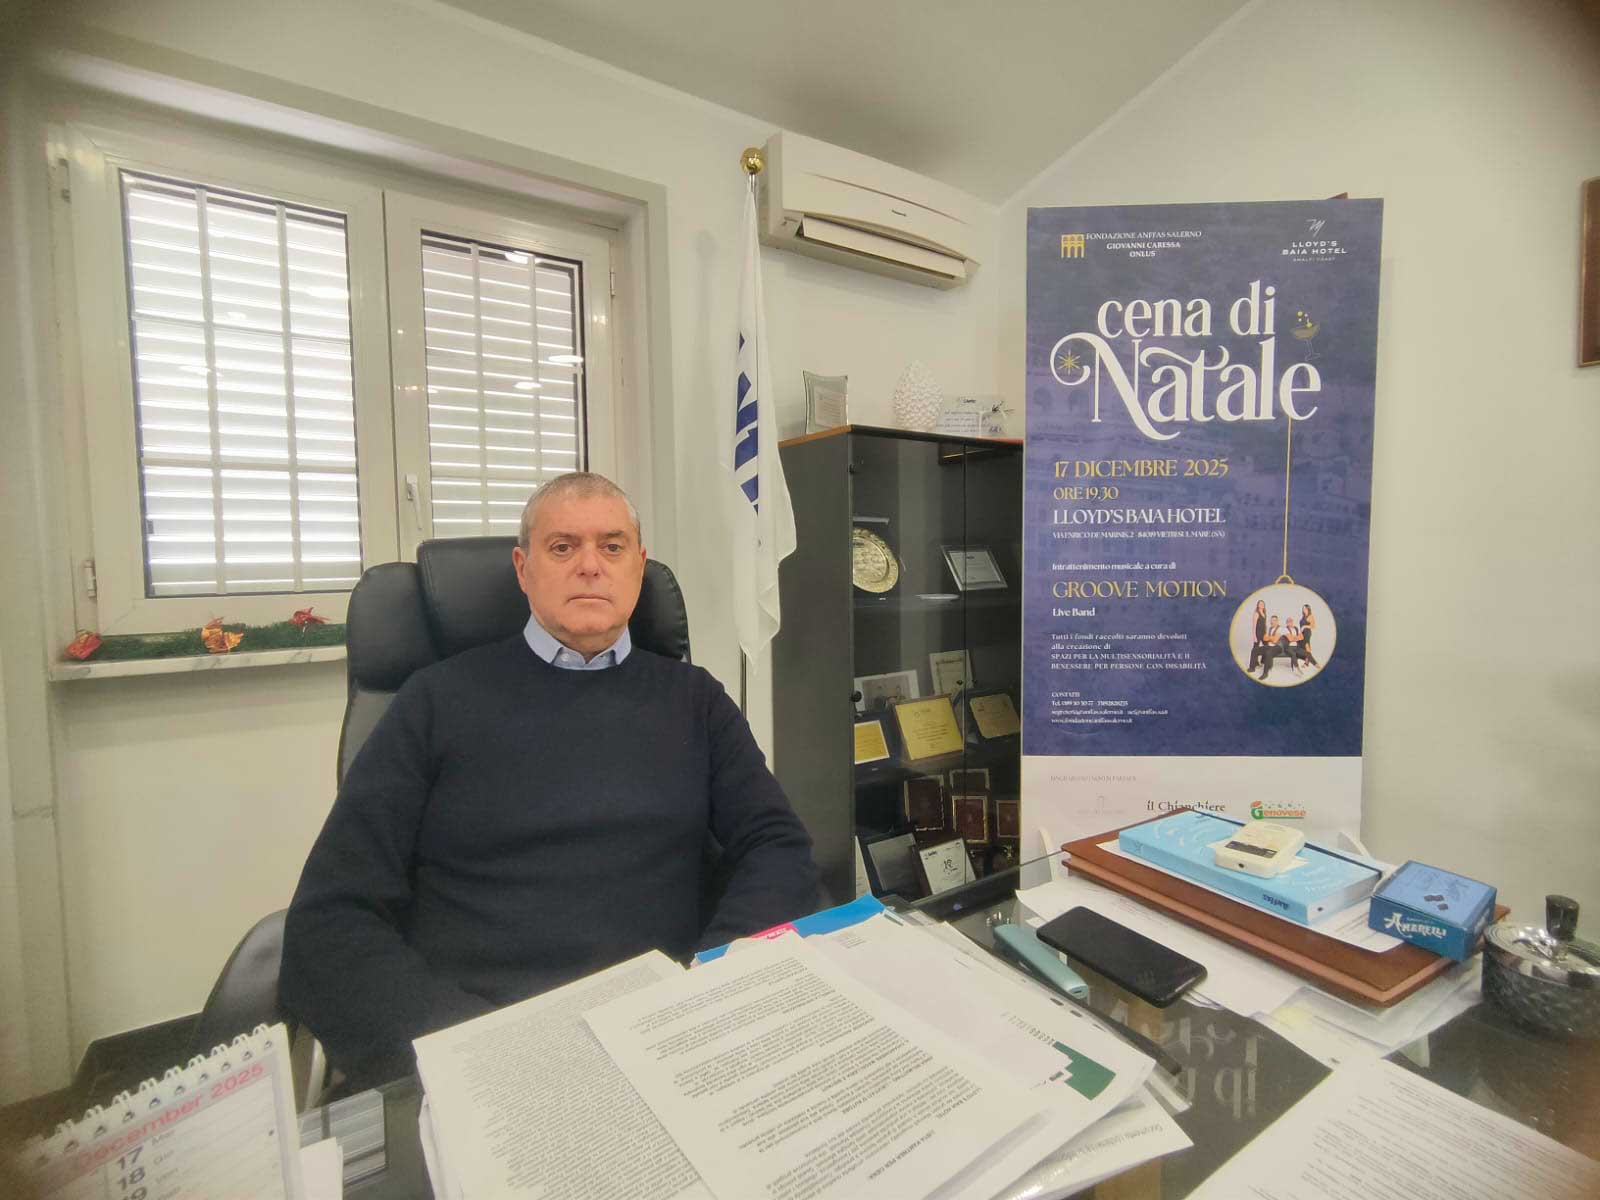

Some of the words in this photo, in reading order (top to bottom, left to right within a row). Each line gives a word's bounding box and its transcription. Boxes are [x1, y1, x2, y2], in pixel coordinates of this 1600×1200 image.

[1086, 232, 1136, 240] FONDAZIONE
[1166, 230, 1202, 239] SALERNO
[1292, 240, 1337, 248] LLOYD'S
[1106, 242, 1145, 250] GIOVANNI
[1146, 241, 1181, 249] CARESSA
[1129, 250, 1156, 258] ONLUS
[1097, 298, 1213, 339] cena
[1229, 279, 1276, 336] di
[1050, 331, 1322, 441] Natale
[1055, 460, 1070, 478] 17
[1075, 459, 1178, 477] DICEMBRE
[1183, 457, 1230, 479] 2025
[1053, 486, 1083, 500] ORE
[1085, 486, 1119, 501] 19.30
[1053, 508, 1124, 525] LLOYD'S
[1126, 508, 1165, 524] BAIA
[1168, 507, 1226, 524] HOTEL
[1052, 562, 1110, 571] Intrattenimento
[1111, 562, 1144, 570] musicale
[1168, 561, 1176, 570] di
[1052, 580, 1139, 598] GROOVE
[1146, 580, 1227, 598] MOTION
[1052, 608, 1071, 617] Live
[1072, 607, 1096, 617] Band
[210, 1064, 265, 1100] 2025
[117, 1146, 144, 1170] 17
[117, 1166, 146, 1191] 18
